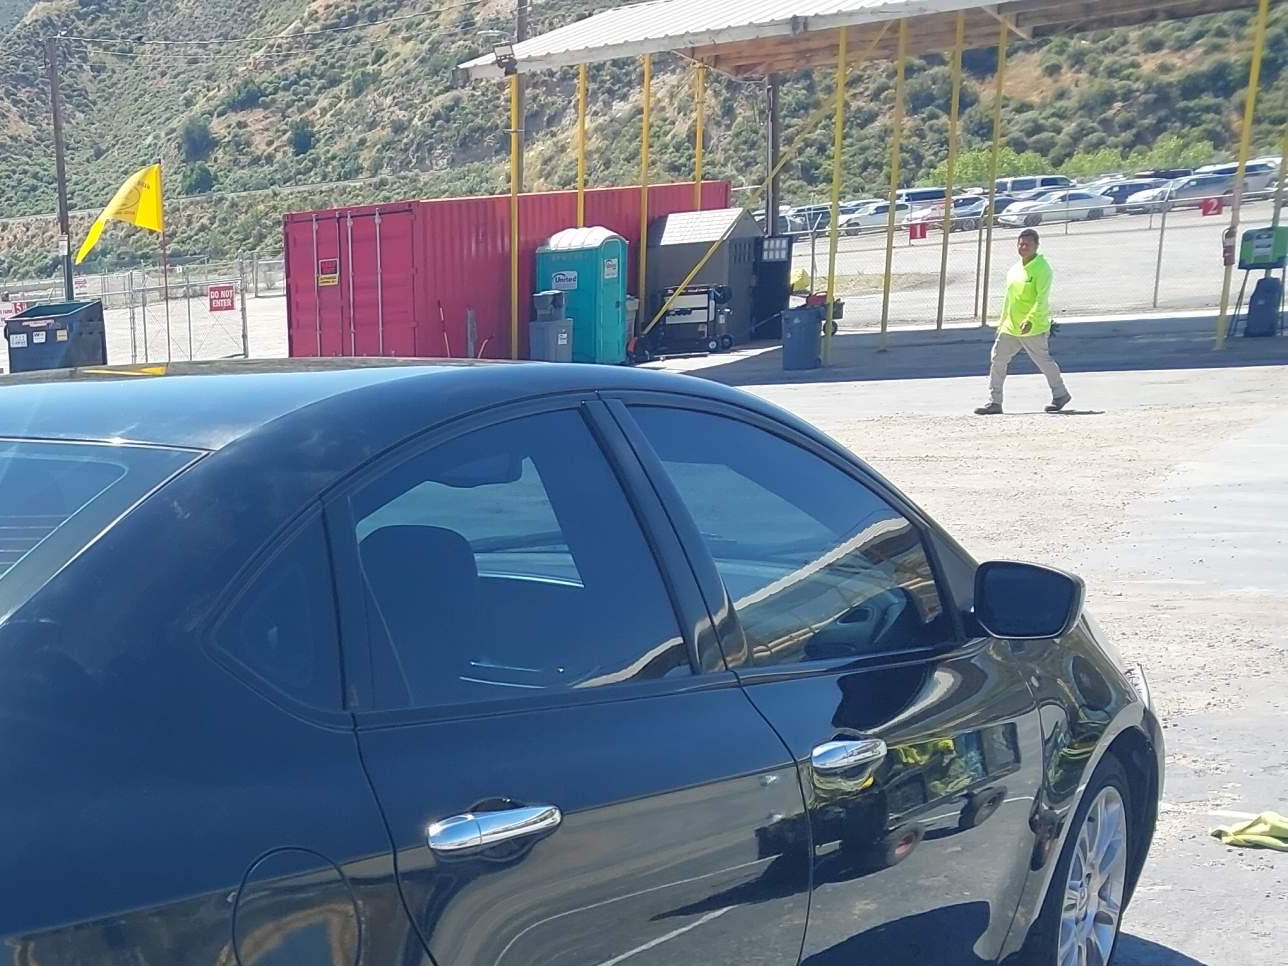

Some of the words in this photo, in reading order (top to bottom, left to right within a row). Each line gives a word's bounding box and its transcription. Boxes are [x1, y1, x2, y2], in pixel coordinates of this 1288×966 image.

[1208, 199, 1218, 215] 2
[221, 290, 233, 298] NOT
[213, 299, 232, 307] ENTER
